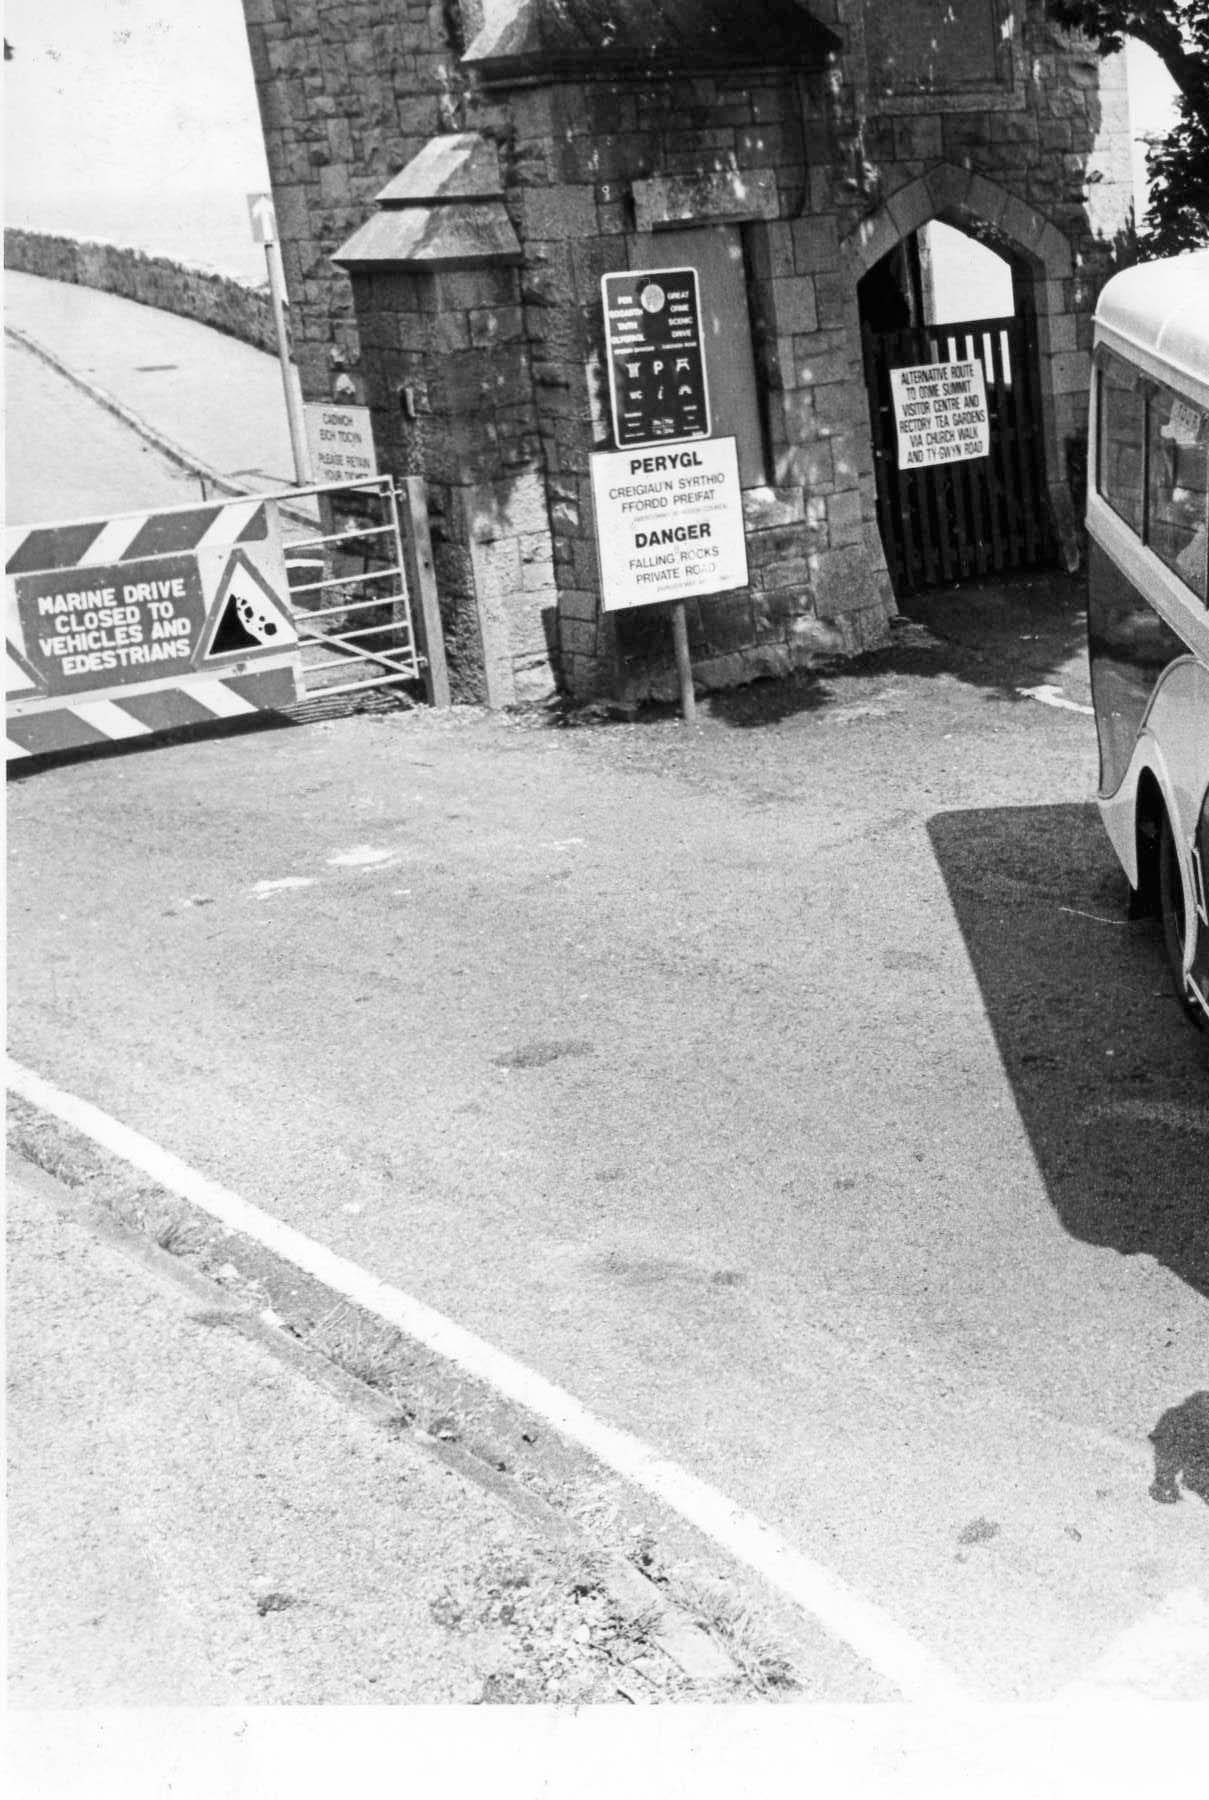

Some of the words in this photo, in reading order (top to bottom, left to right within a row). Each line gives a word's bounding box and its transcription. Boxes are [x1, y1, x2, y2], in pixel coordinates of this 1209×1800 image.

[653, 360, 665, 375] P
[901, 366, 948, 386] ALTERNATIVE
[950, 364, 975, 380] ROUTE
[906, 386, 917, 400] TO
[942, 380, 972, 397] SUMMIT
[902, 401, 930, 417] VISITOR
[932, 396, 961, 414] CENTRE
[963, 393, 979, 408] AND
[900, 417, 932, 434] RECTORY
[935, 414, 950, 429] TEA
[952, 409, 986, 427] GARDENS
[909, 434, 923, 448] VIA
[926, 429, 955, 446] CHURCH
[957, 426, 979, 441] WALK
[318, 451, 344, 466] PLEASE
[630, 451, 704, 476] PERYGL
[907, 450, 924, 464] AND
[964, 441, 983, 456] ROAD
[608, 480, 674, 501] CREIGIAU'N
[678, 472, 726, 490] SYRTHIO
[621, 496, 669, 514] FFORDD
[673, 489, 716, 505] PREIFAT
[634, 523, 712, 549] DANGER
[628, 553, 676, 571] FALLING
[680, 546, 720, 563] ROCKS
[635, 567, 681, 585] PRIVATE
[37, 587, 118, 616] MARINE
[123, 578, 187, 604] DRIVE
[54, 605, 141, 634] CLOSED
[147, 601, 175, 620] TO
[38, 625, 143, 657] VEHICLES
[151, 616, 192, 640] AND
[61, 638, 191, 676] EDESTRIANS
